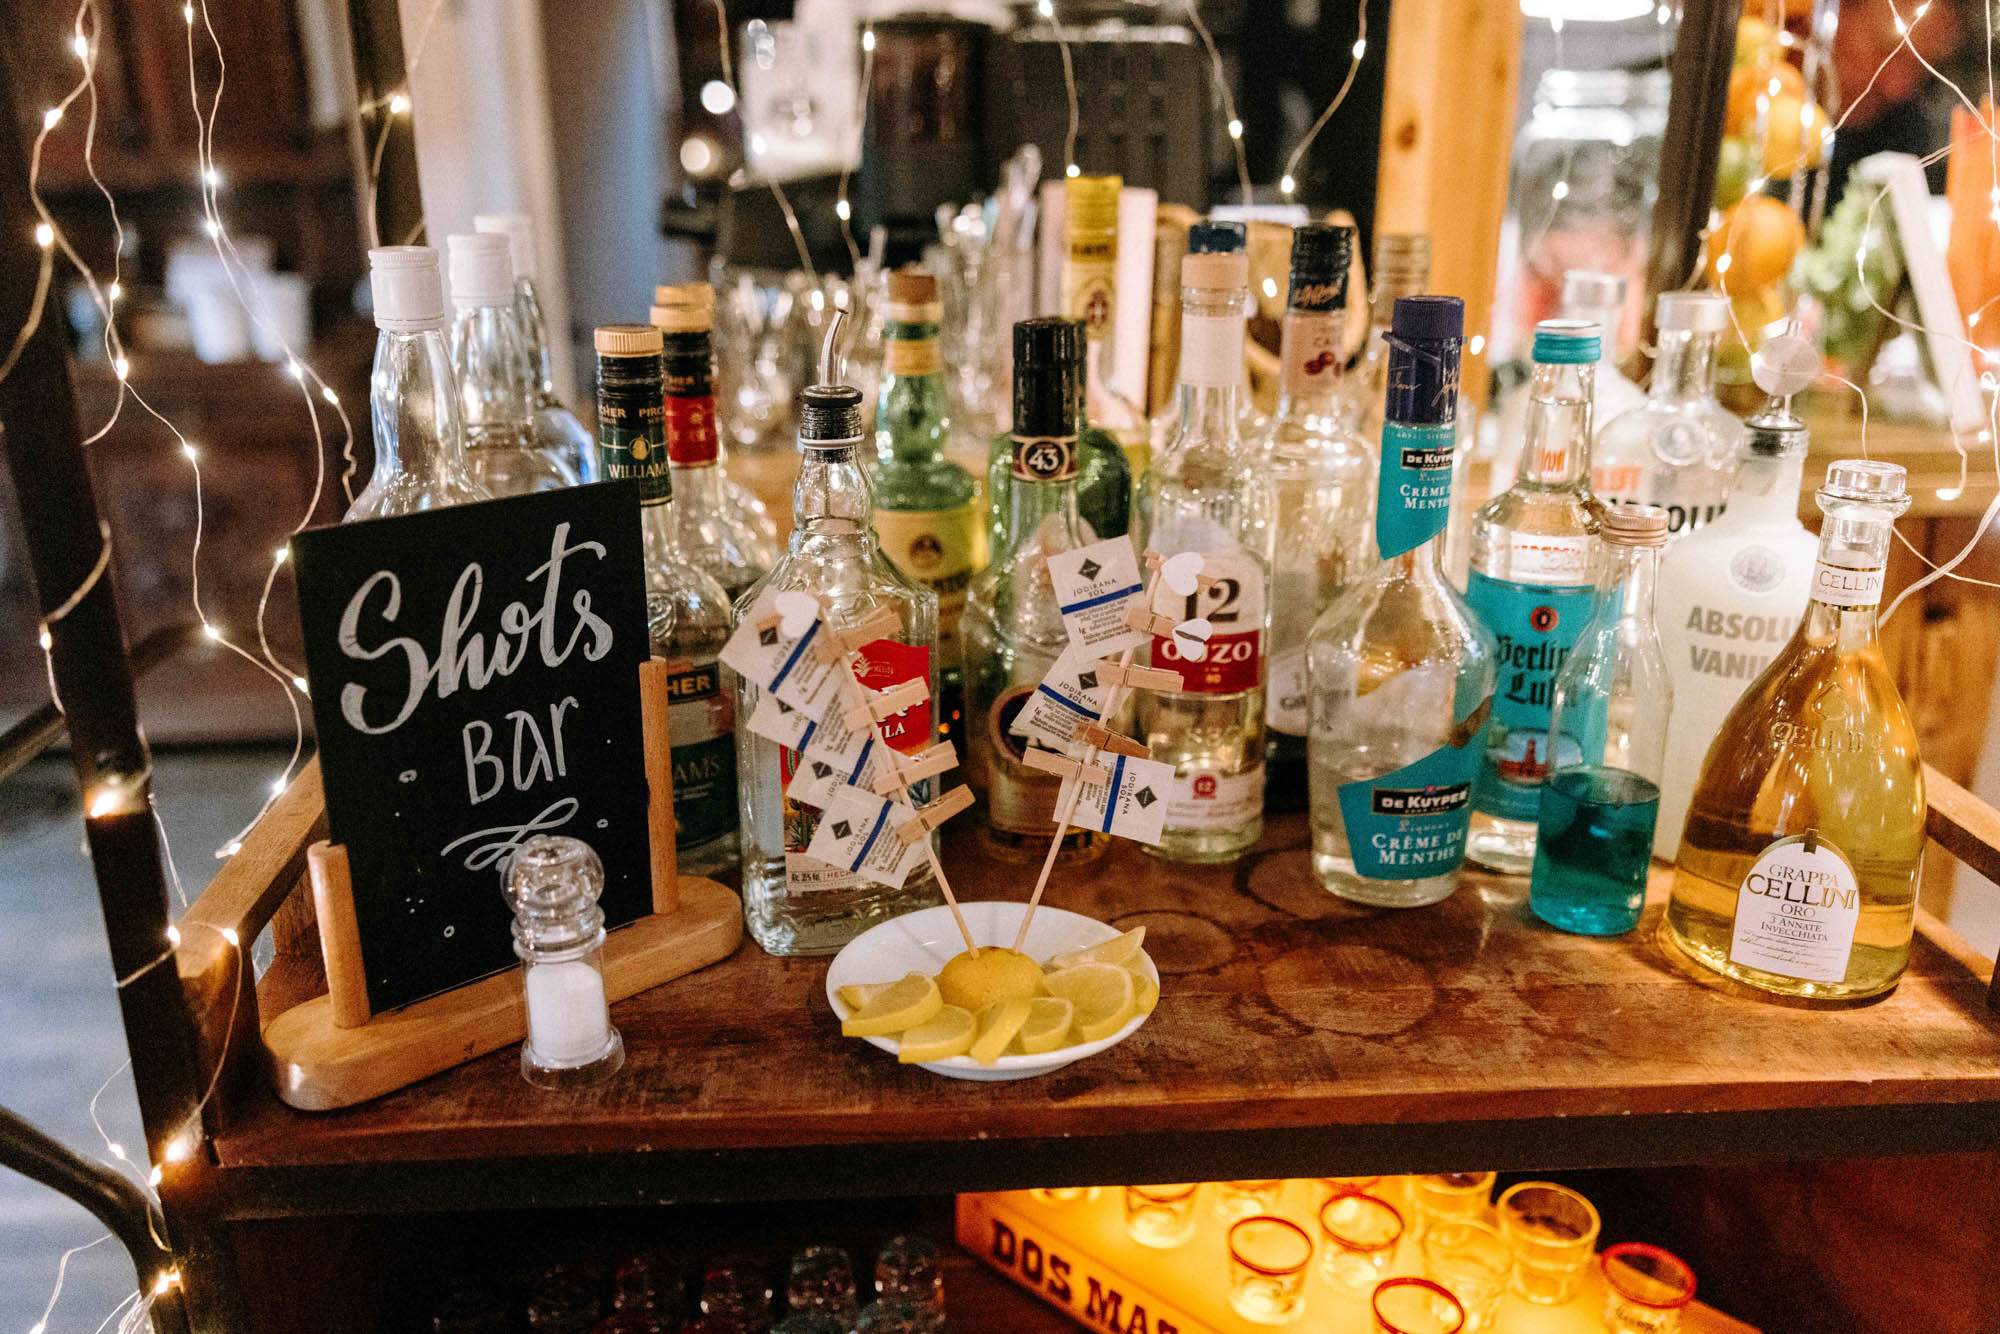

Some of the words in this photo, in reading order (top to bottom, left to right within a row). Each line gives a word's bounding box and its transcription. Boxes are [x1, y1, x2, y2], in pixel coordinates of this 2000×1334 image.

[1028, 449, 1060, 471] 43
[1183, 578, 1241, 622] 12
[338, 521, 614, 736] Shots
[1381, 797, 1405, 809] DE
[1769, 863, 1840, 888] GRAPPA
[1746, 873, 1857, 910] CELLINI
[1781, 903, 1817, 918] ORO
[991, 1218, 1072, 1300] DOS
